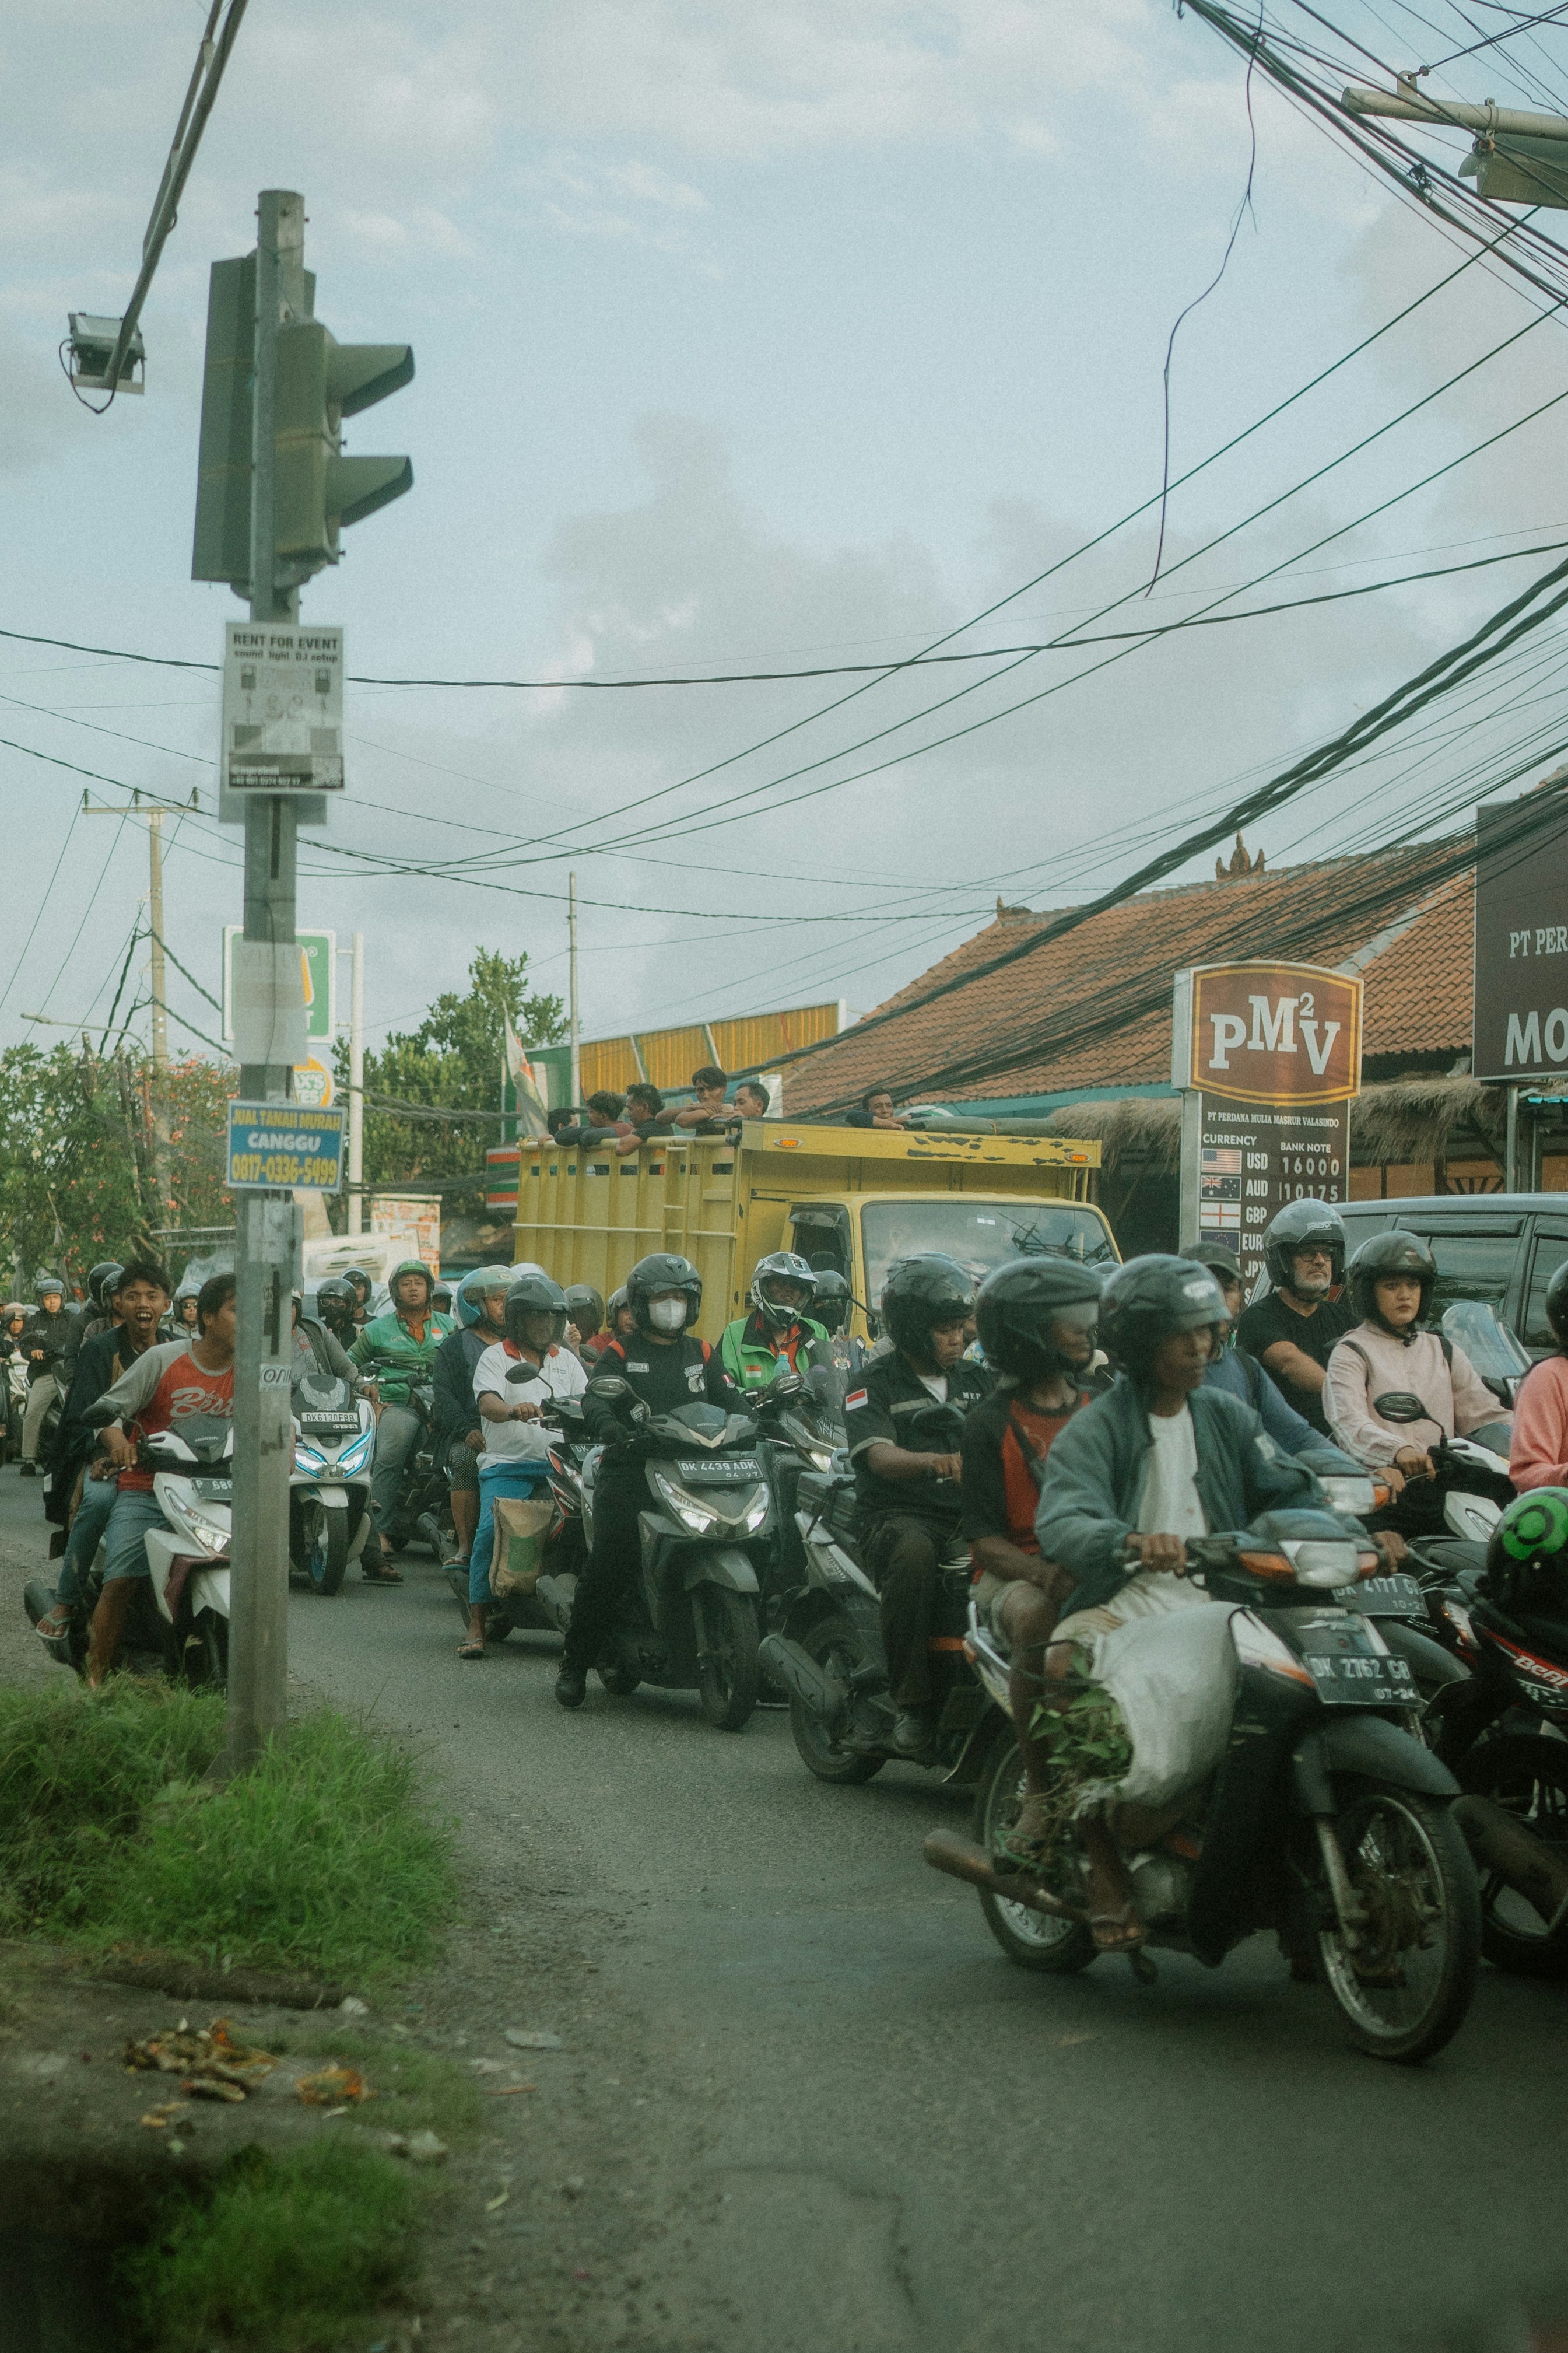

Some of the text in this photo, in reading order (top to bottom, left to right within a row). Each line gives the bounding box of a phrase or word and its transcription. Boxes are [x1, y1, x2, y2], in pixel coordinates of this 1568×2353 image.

[234, 633, 338, 650] RENT FOR EVENT
[1510, 925, 1568, 958] PT PER
[1504, 1007, 1568, 1066] MO
[233, 1109, 341, 1131] JUAL TANAH MURAH
[1208, 1111, 1339, 1128] PT PERDANA MULIA MASRUR VALASINDO
[248, 1132, 321, 1153] CANGGU
[1202, 1133, 1257, 1146] CURRENCY
[1280, 1142, 1331, 1154] BANK NOTE
[1247, 1152, 1339, 1176] USD 16000
[1246, 1179, 1268, 1197] AUD
[1246, 1206, 1267, 1224] GBP
[169, 1386, 233, 1419] Best
[681, 1461, 757, 1472] DK 4439 ADK
[559, 1496, 574, 1511] HONDA
[1309, 1657, 1337, 1678] DK
[1340, 1658, 1384, 1678] 2762
